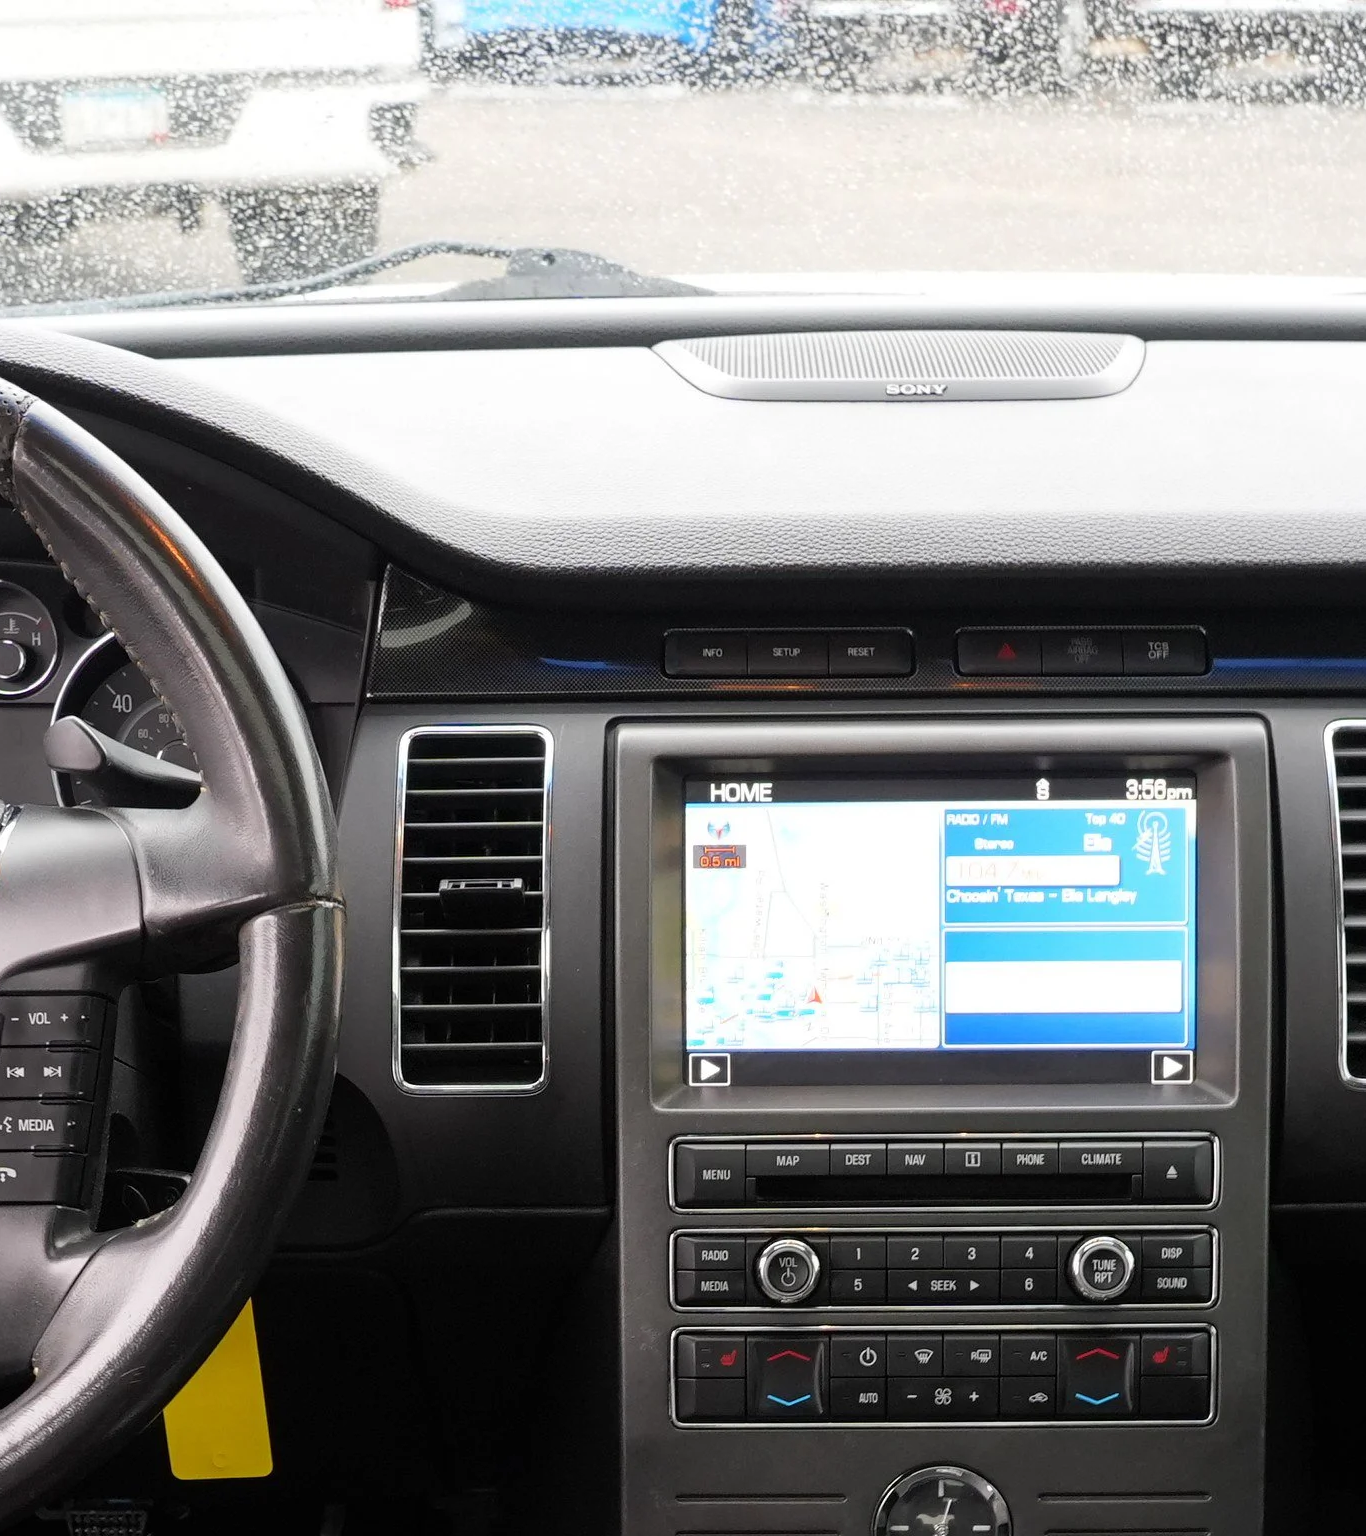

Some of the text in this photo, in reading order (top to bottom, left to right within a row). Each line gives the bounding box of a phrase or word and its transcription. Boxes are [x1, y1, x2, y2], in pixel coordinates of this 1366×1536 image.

[885, 383, 948, 396] SONY
[31, 632, 41, 647] H
[702, 648, 723, 658] INFO
[772, 647, 801, 657] SETUP
[847, 647, 876, 657] RESET
[1148, 650, 1169, 660] OFF
[112, 694, 133, 713] 40
[137, 728, 149, 739] 60
[710, 782, 773, 803] HOME
[946, 813, 980, 826] RADIO
[990, 813, 1009, 825] FM
[1085, 812, 1126, 827] Top 40
[974, 837, 1015, 851] Stereo
[700, 856, 721, 868] 0.5
[1004, 889, 1045, 903] Texas
[28, 1012, 51, 1025] VOL
[18, 1119, 55, 1132] MEDIA
[776, 1155, 800, 1167] MAP
[845, 1153, 872, 1166] DEST
[904, 1154, 927, 1166] NAV
[1016, 1153, 1045, 1166] PHONE
[1081, 1152, 1122, 1166] CLIMATE
[702, 1169, 731, 1181] MENU
[701, 1249, 729, 1262] RADIO
[855, 1247, 862, 1261] 1
[910, 1247, 920, 1261] 2
[967, 1246, 977, 1261] 3
[1024, 1246, 1034, 1260] 4
[1161, 1247, 1183, 1260] DISP
[778, 1256, 799, 1269] VOL
[1092, 1258, 1117, 1272] TUNE
[853, 1278, 863, 1291] 5
[1024, 1277, 1034, 1291] 6
[1094, 1271, 1114, 1285] RPT
[1156, 1277, 1188, 1290] SOUND
[700, 1280, 729, 1292] MEDIA
[930, 1279, 957, 1292] SEEK
[1029, 1350, 1048, 1362] A/C
[858, 1392, 879, 1404] AUTO
